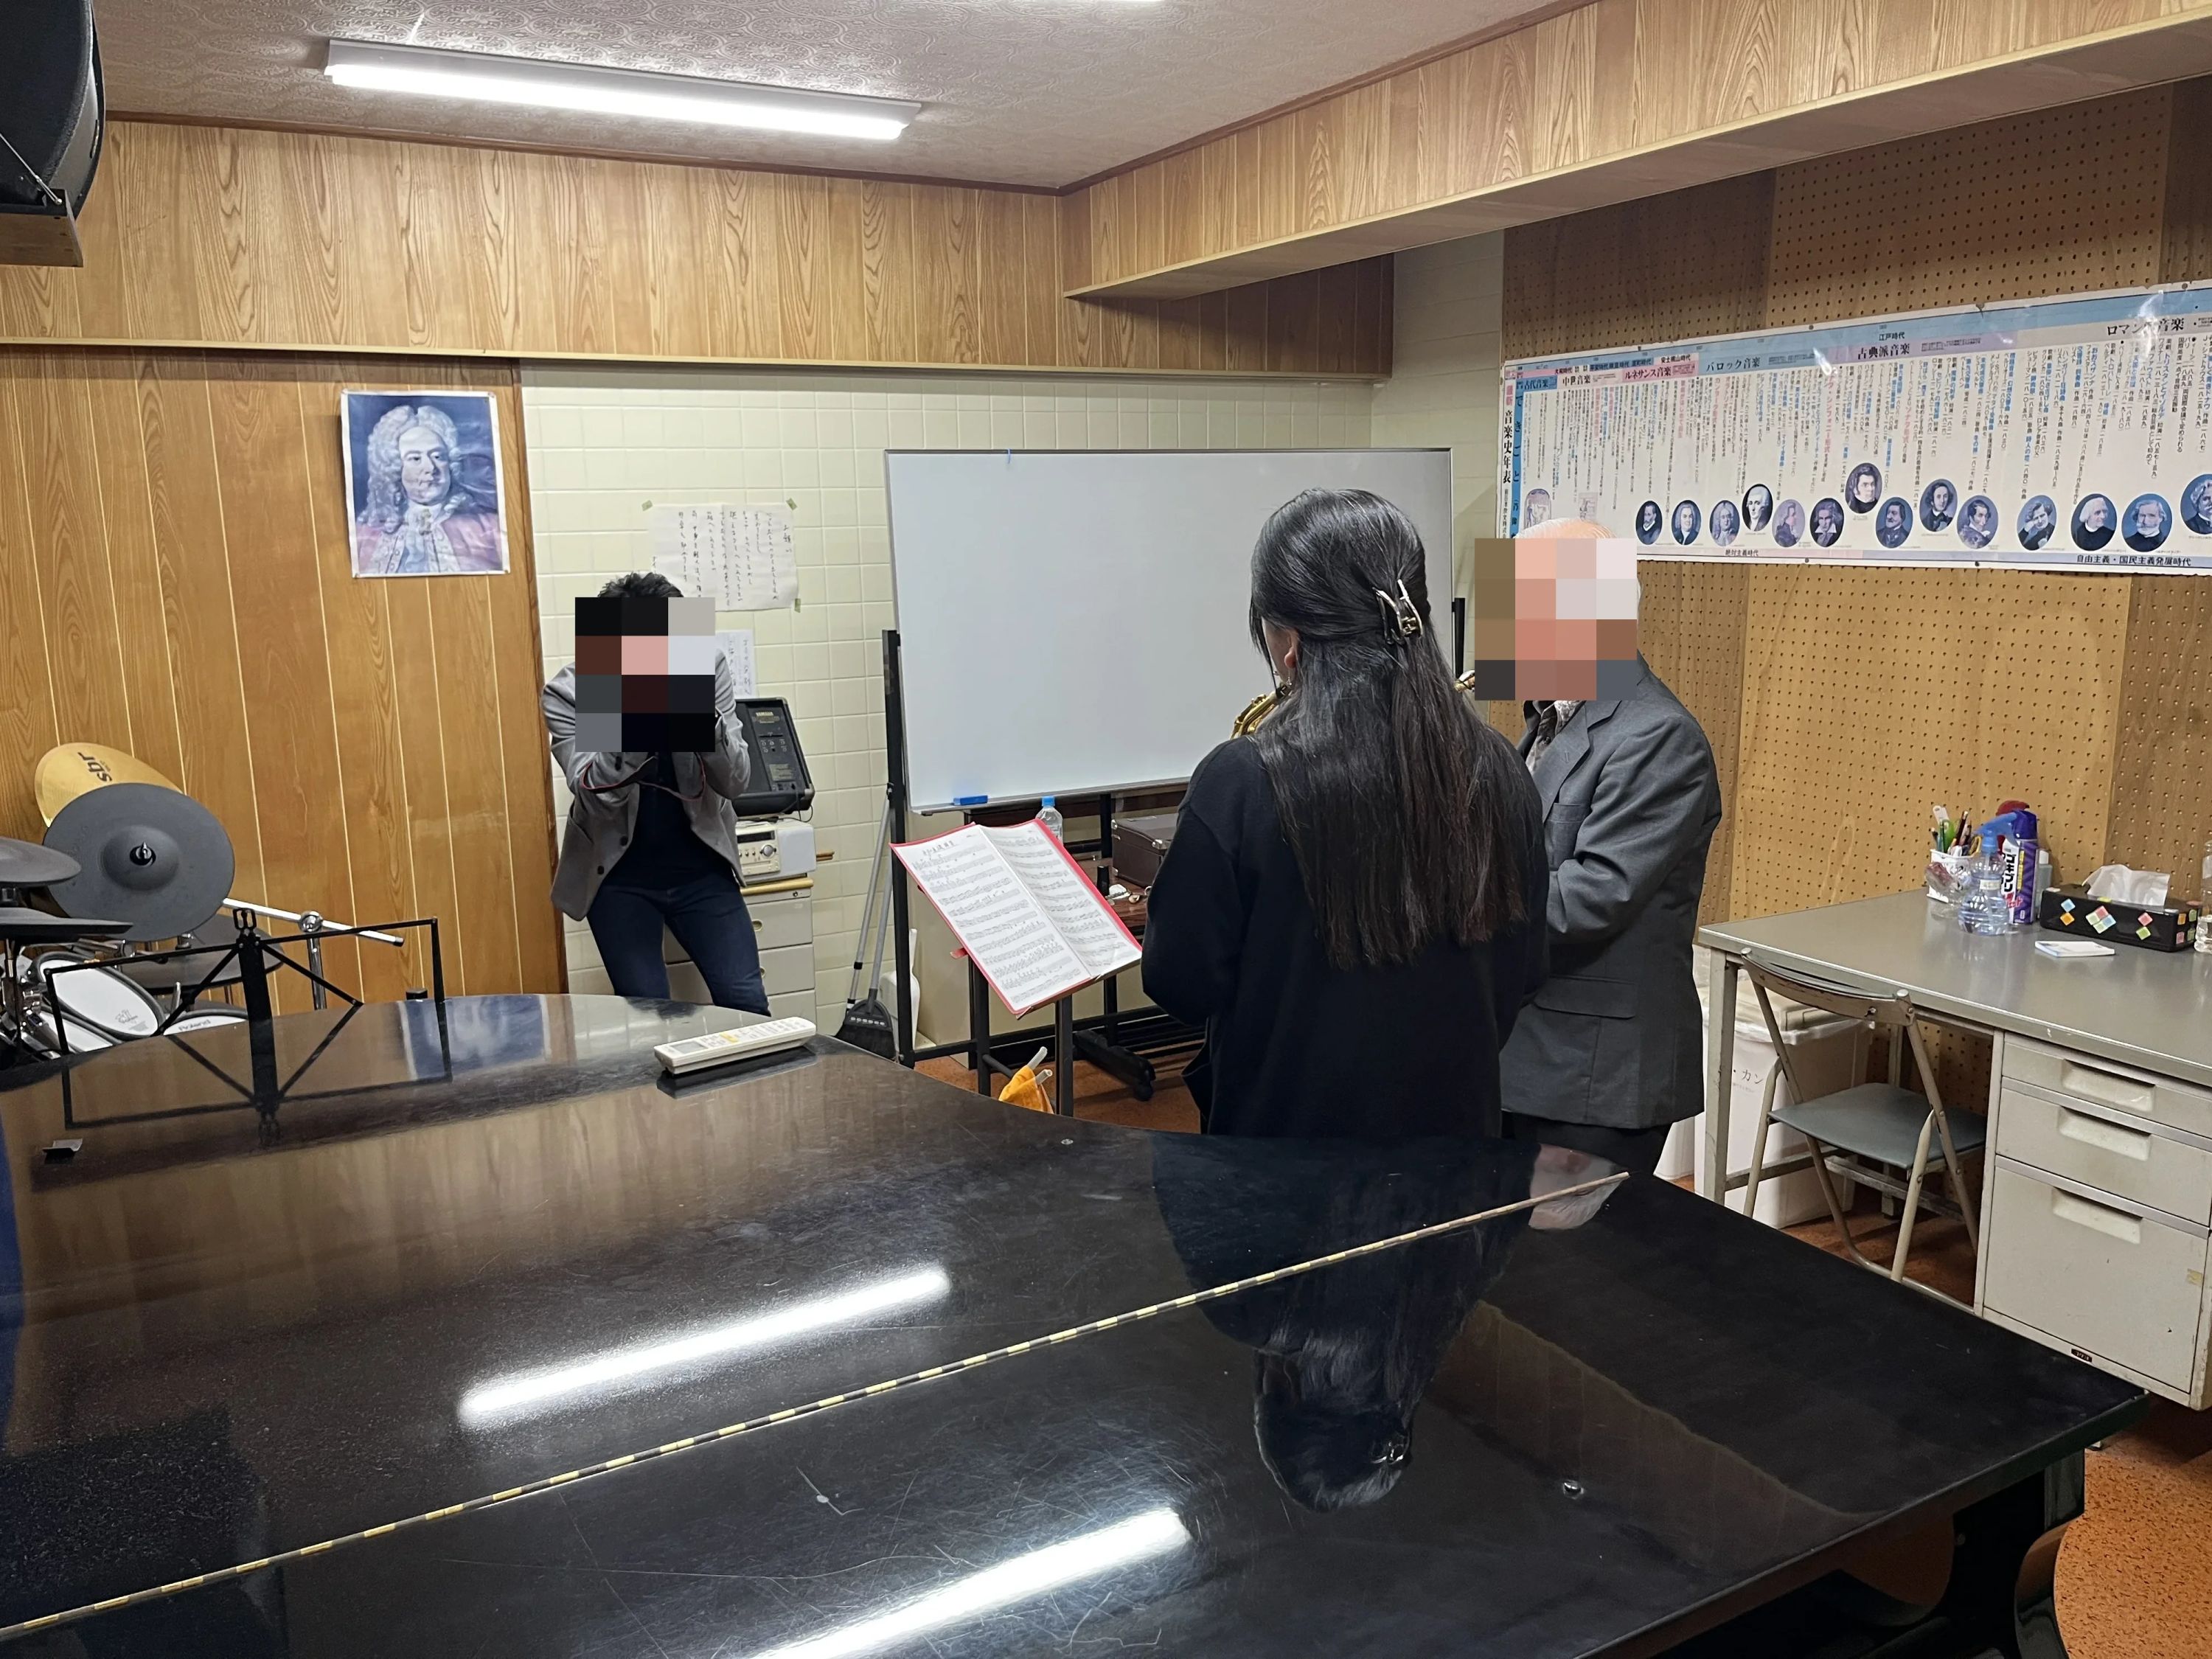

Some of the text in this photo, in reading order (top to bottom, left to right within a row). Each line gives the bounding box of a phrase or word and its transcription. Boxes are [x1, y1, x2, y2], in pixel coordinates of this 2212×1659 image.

[1879, 332, 1905, 342] 江戸時代
[1857, 343, 1910, 360] 古典派音楽
[1706, 357, 1761, 372] バロック音楽
[1624, 366, 1672, 380] ルネサンス音楽
[1523, 379, 1548, 391] 古代音楽
[1562, 375, 1591, 387] 中世音楽
[1514, 394, 1523, 483] できごと
[1503, 409, 1514, 484] 音楽史年表
[2076, 554, 2191, 566] 自由主義・国民主義発展時代
